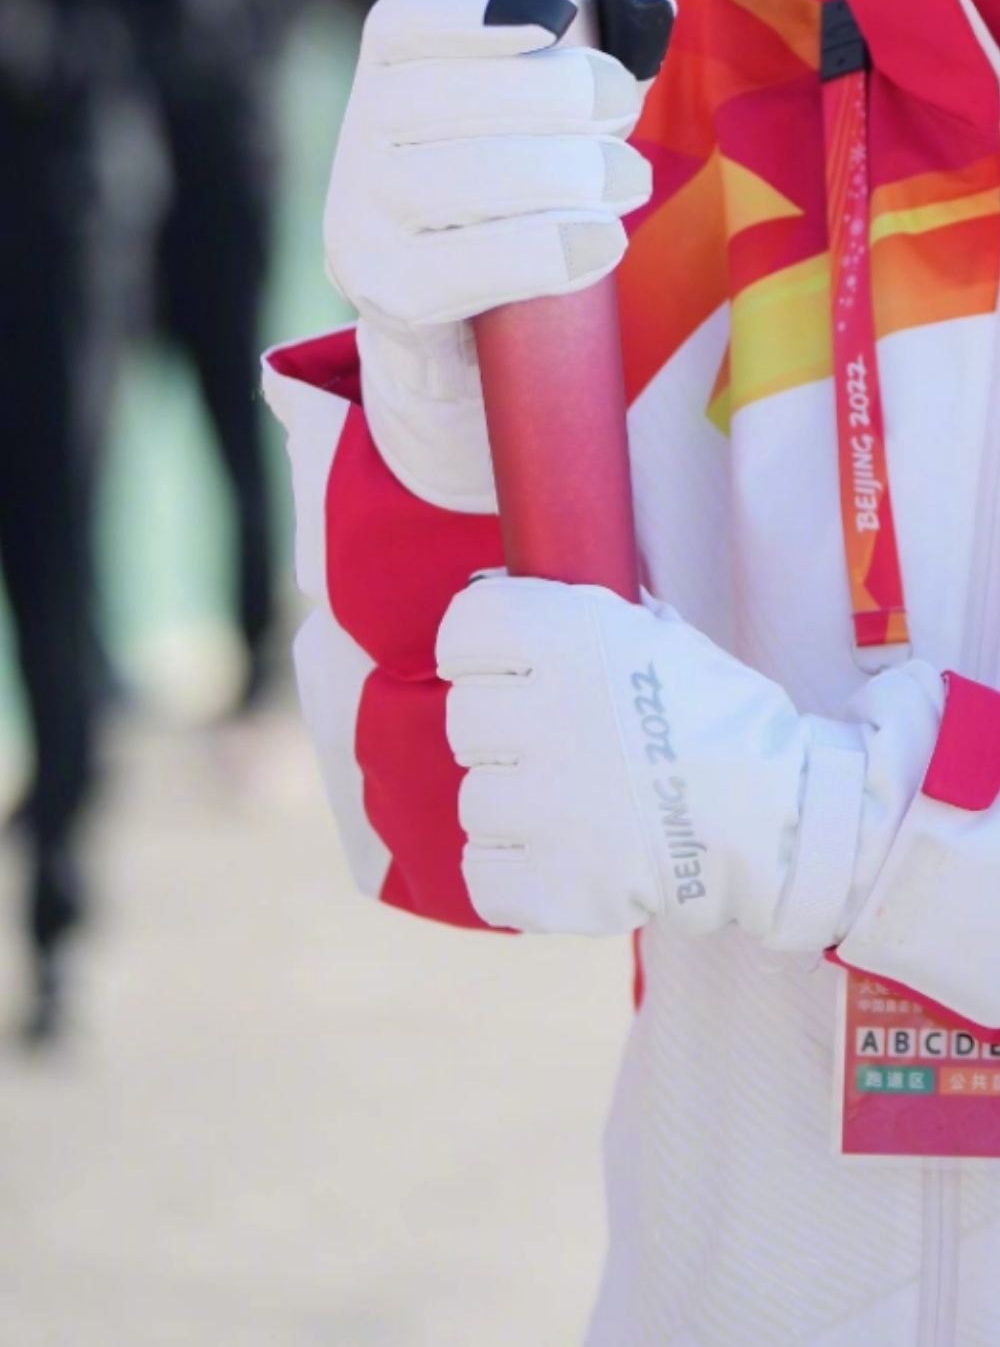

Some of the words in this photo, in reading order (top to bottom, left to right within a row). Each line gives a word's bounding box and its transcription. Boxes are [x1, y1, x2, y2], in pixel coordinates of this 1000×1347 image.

[846, 355, 872, 428] 2022
[850, 433, 883, 534] BEIJING
[630, 661, 677, 765] 2022
[652, 774, 707, 905] BEIJING
